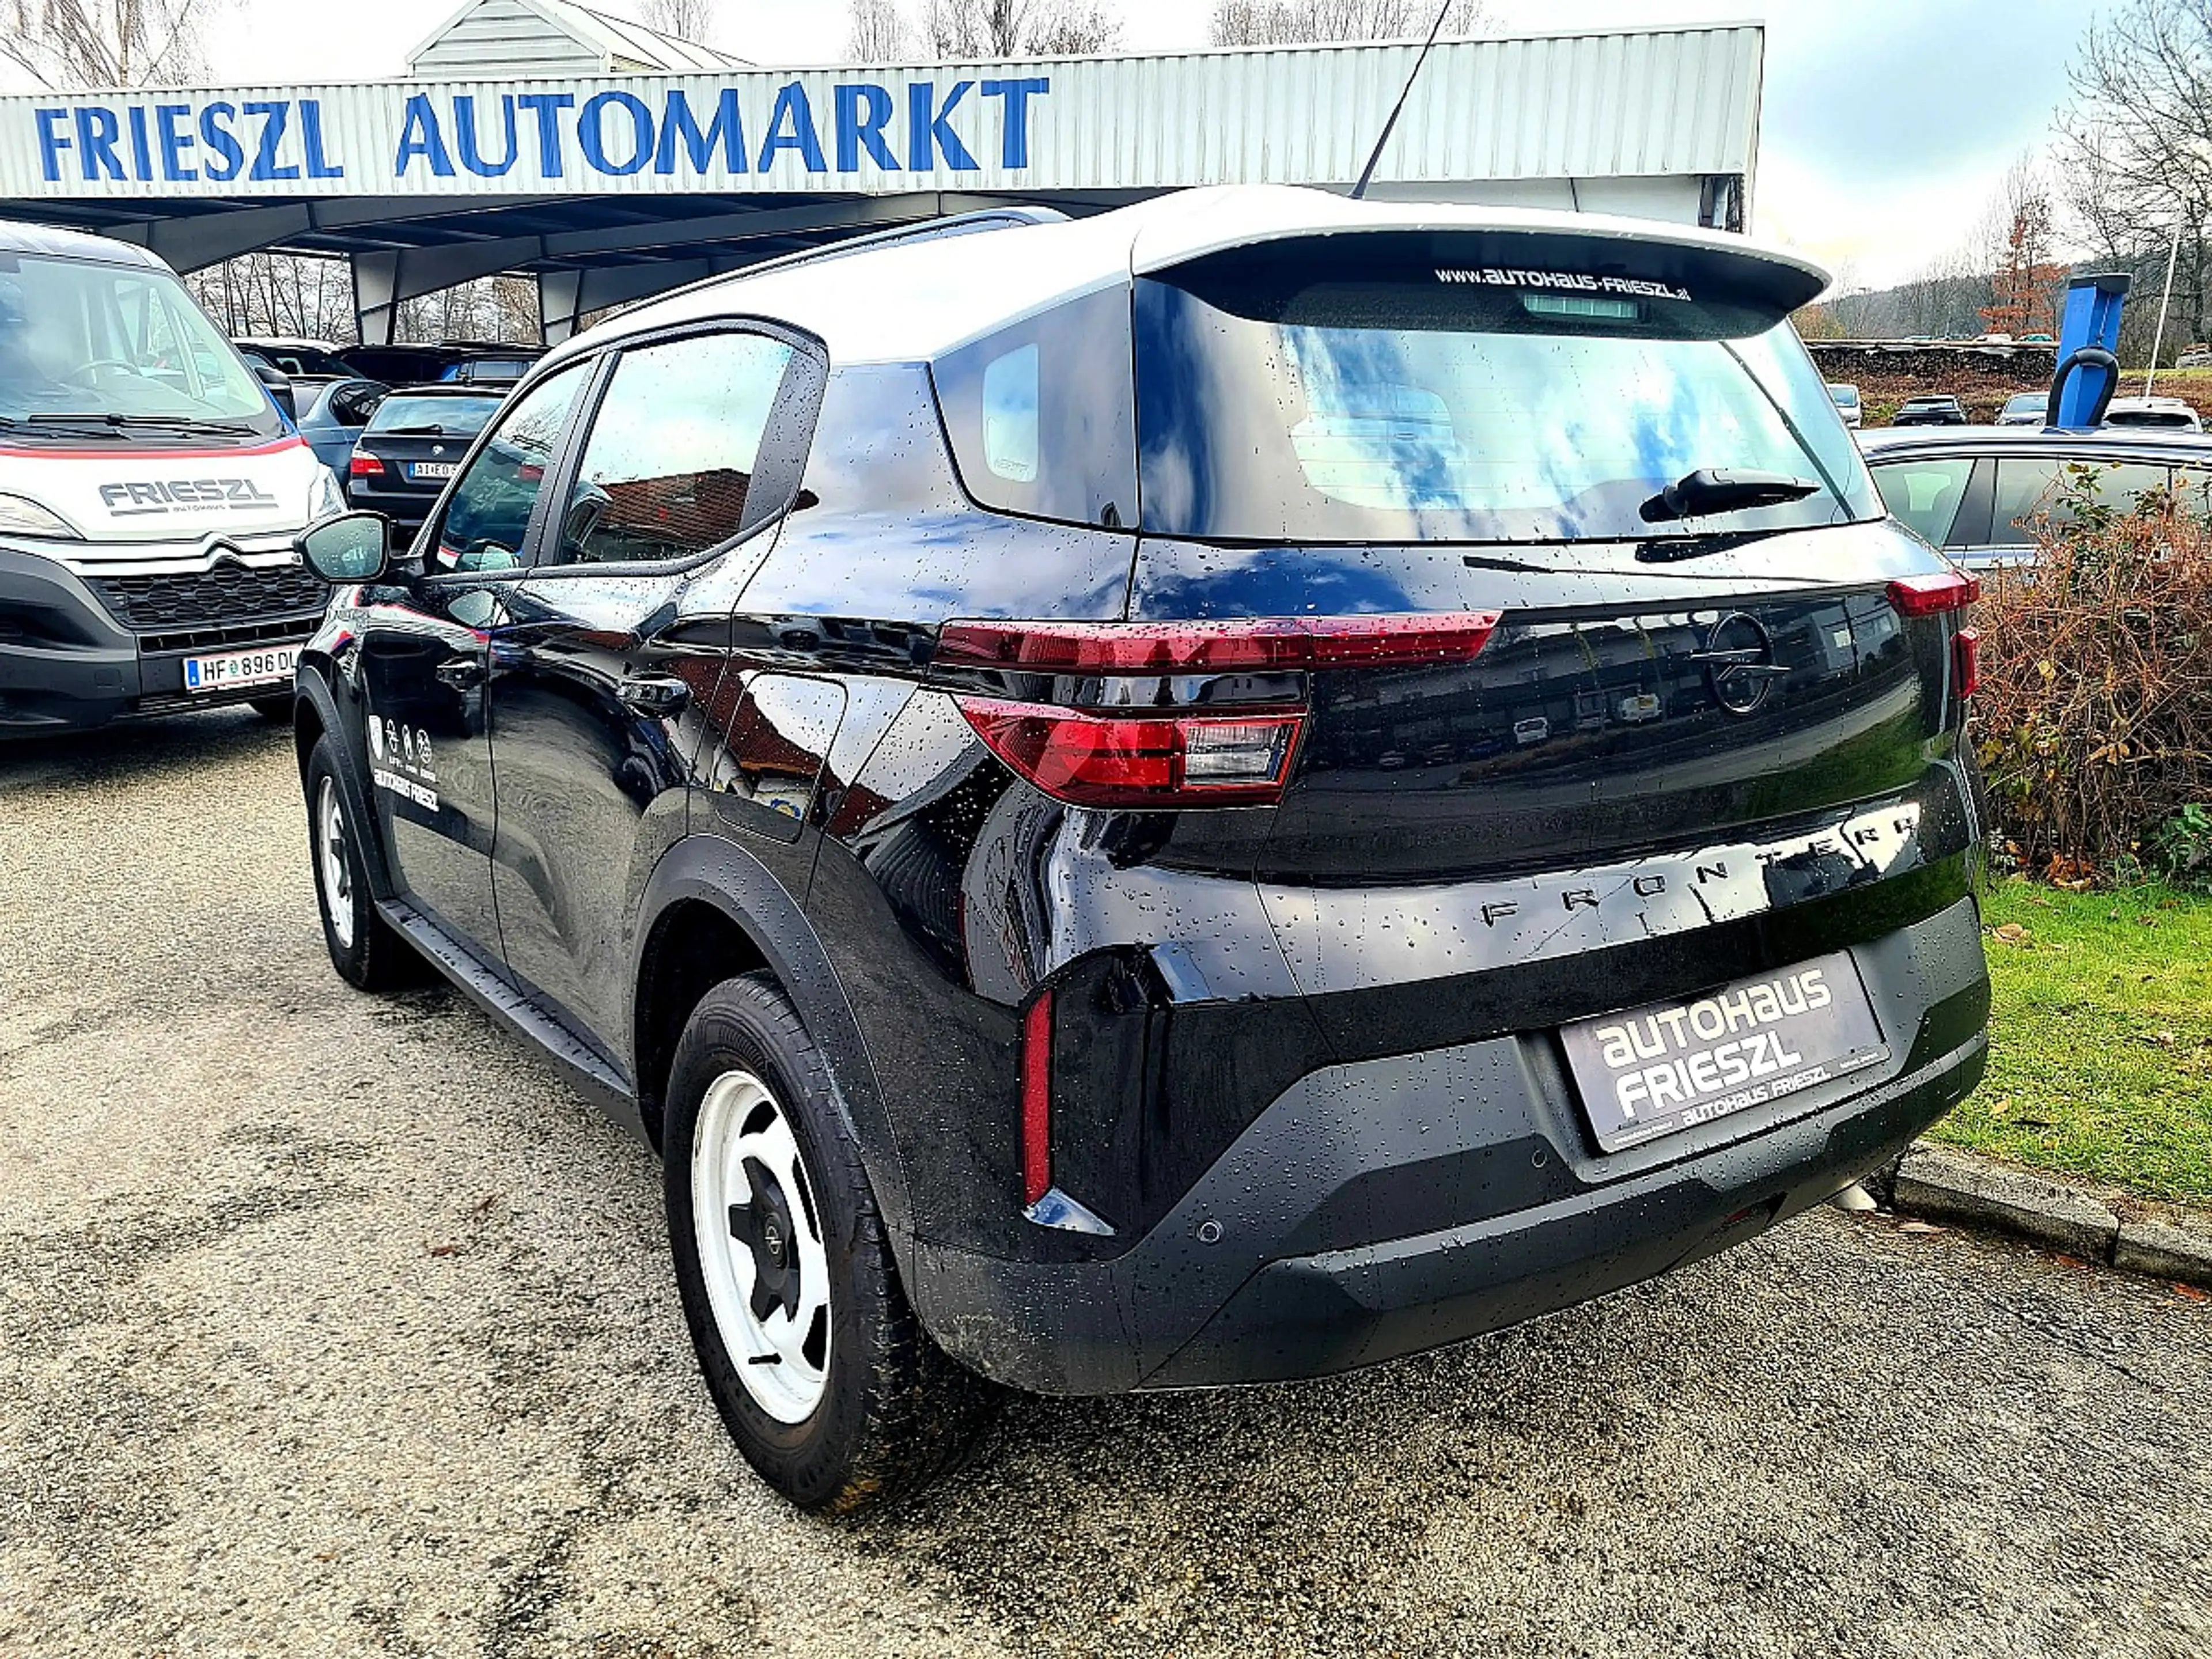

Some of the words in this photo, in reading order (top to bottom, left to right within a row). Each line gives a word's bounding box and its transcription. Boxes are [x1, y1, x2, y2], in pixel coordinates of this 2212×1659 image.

[35, 99, 344, 181] FRIESZL
[395, 77, 1049, 178] AUTOMARKT
[99, 479, 275, 506] FRIESZL
[203, 660, 226, 681] HF
[241, 654, 274, 676] 896
[1480, 815, 1916, 927] FRONTERA
[1613, 1031, 1802, 1119] FRIESZL
[1771, 1066, 1831, 1101] FRIESZL
